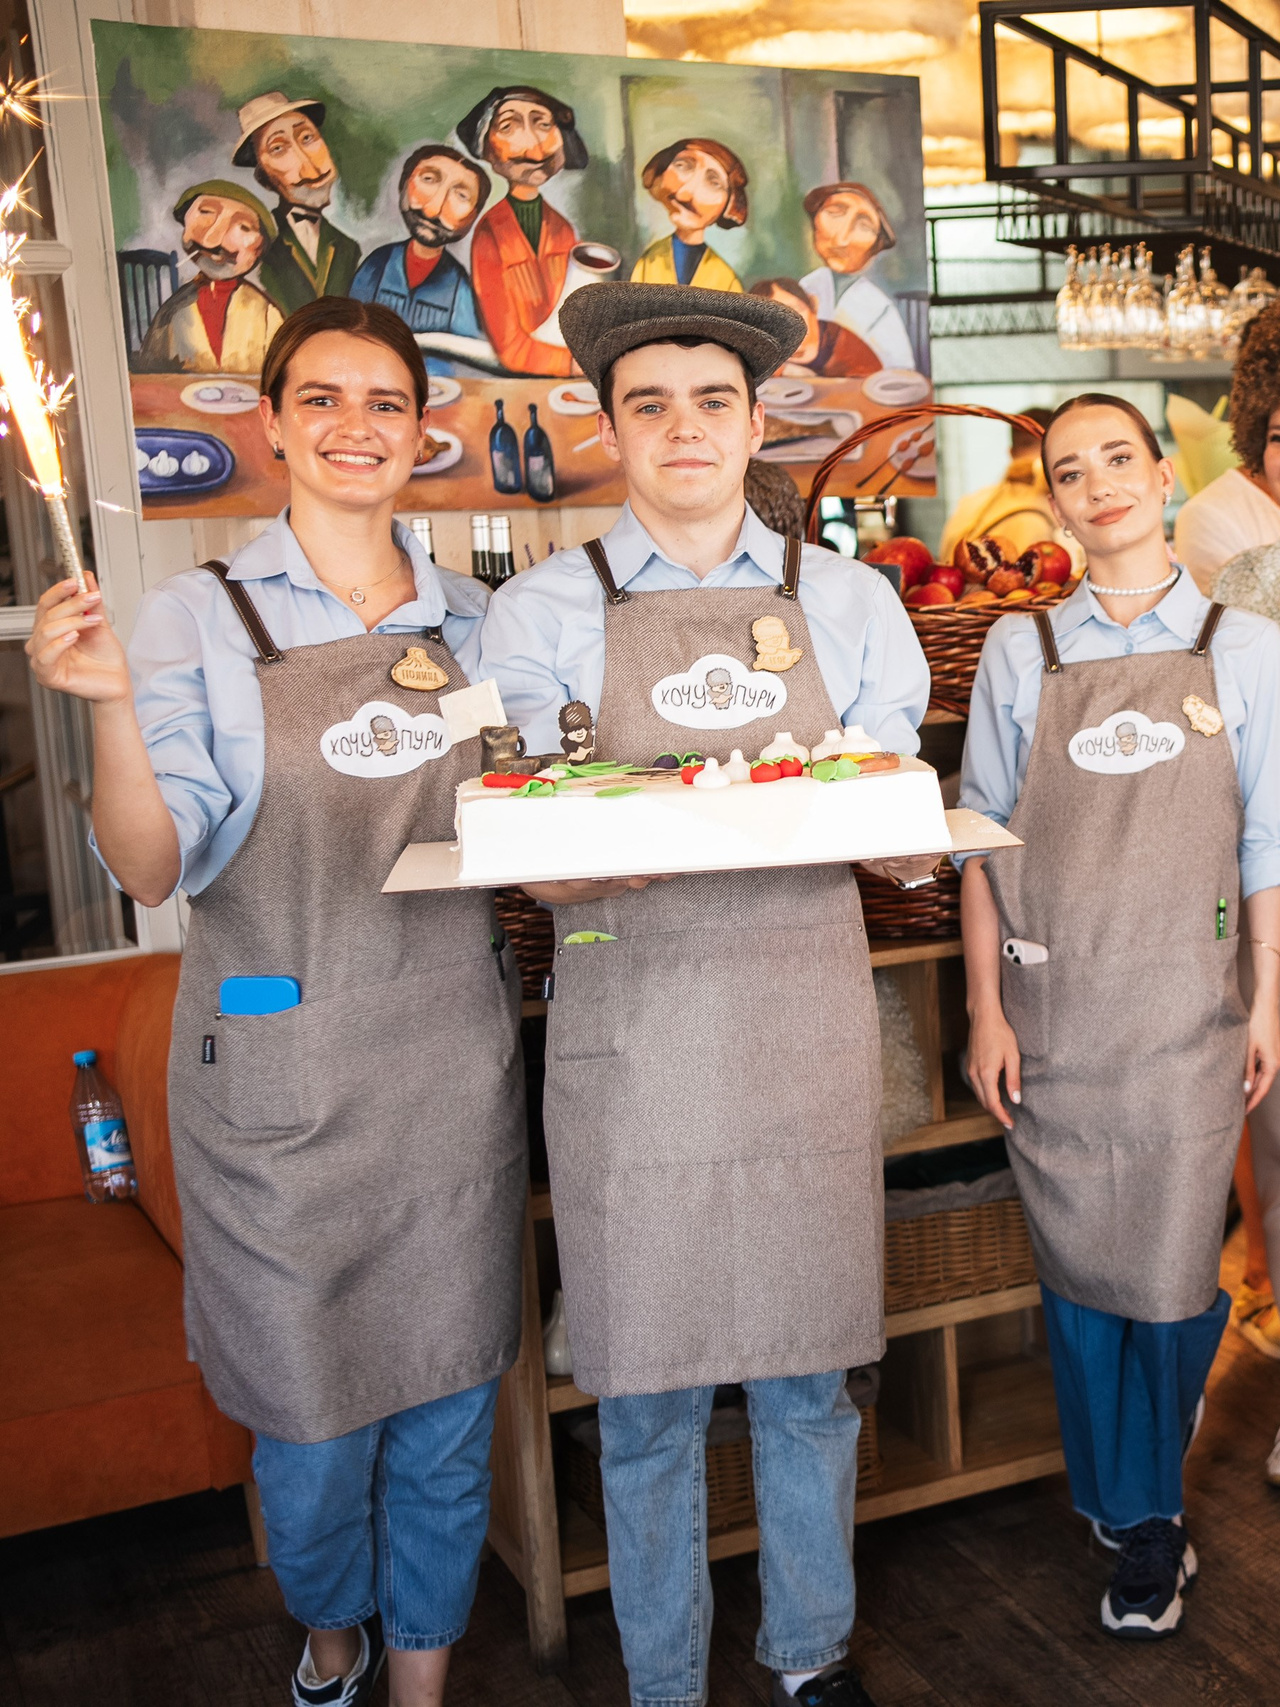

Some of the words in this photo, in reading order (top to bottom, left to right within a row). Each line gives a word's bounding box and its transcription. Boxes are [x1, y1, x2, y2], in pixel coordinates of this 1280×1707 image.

[661, 684, 707, 709] ХОЧУ
[733, 684, 776, 709] ПУРИ
[330, 732, 371, 757] ХОЧУ
[400, 729, 443, 751] ПУРИ
[1077, 735, 1116, 757] ХОЧУ
[1138, 734, 1175, 754] ПУРИ
